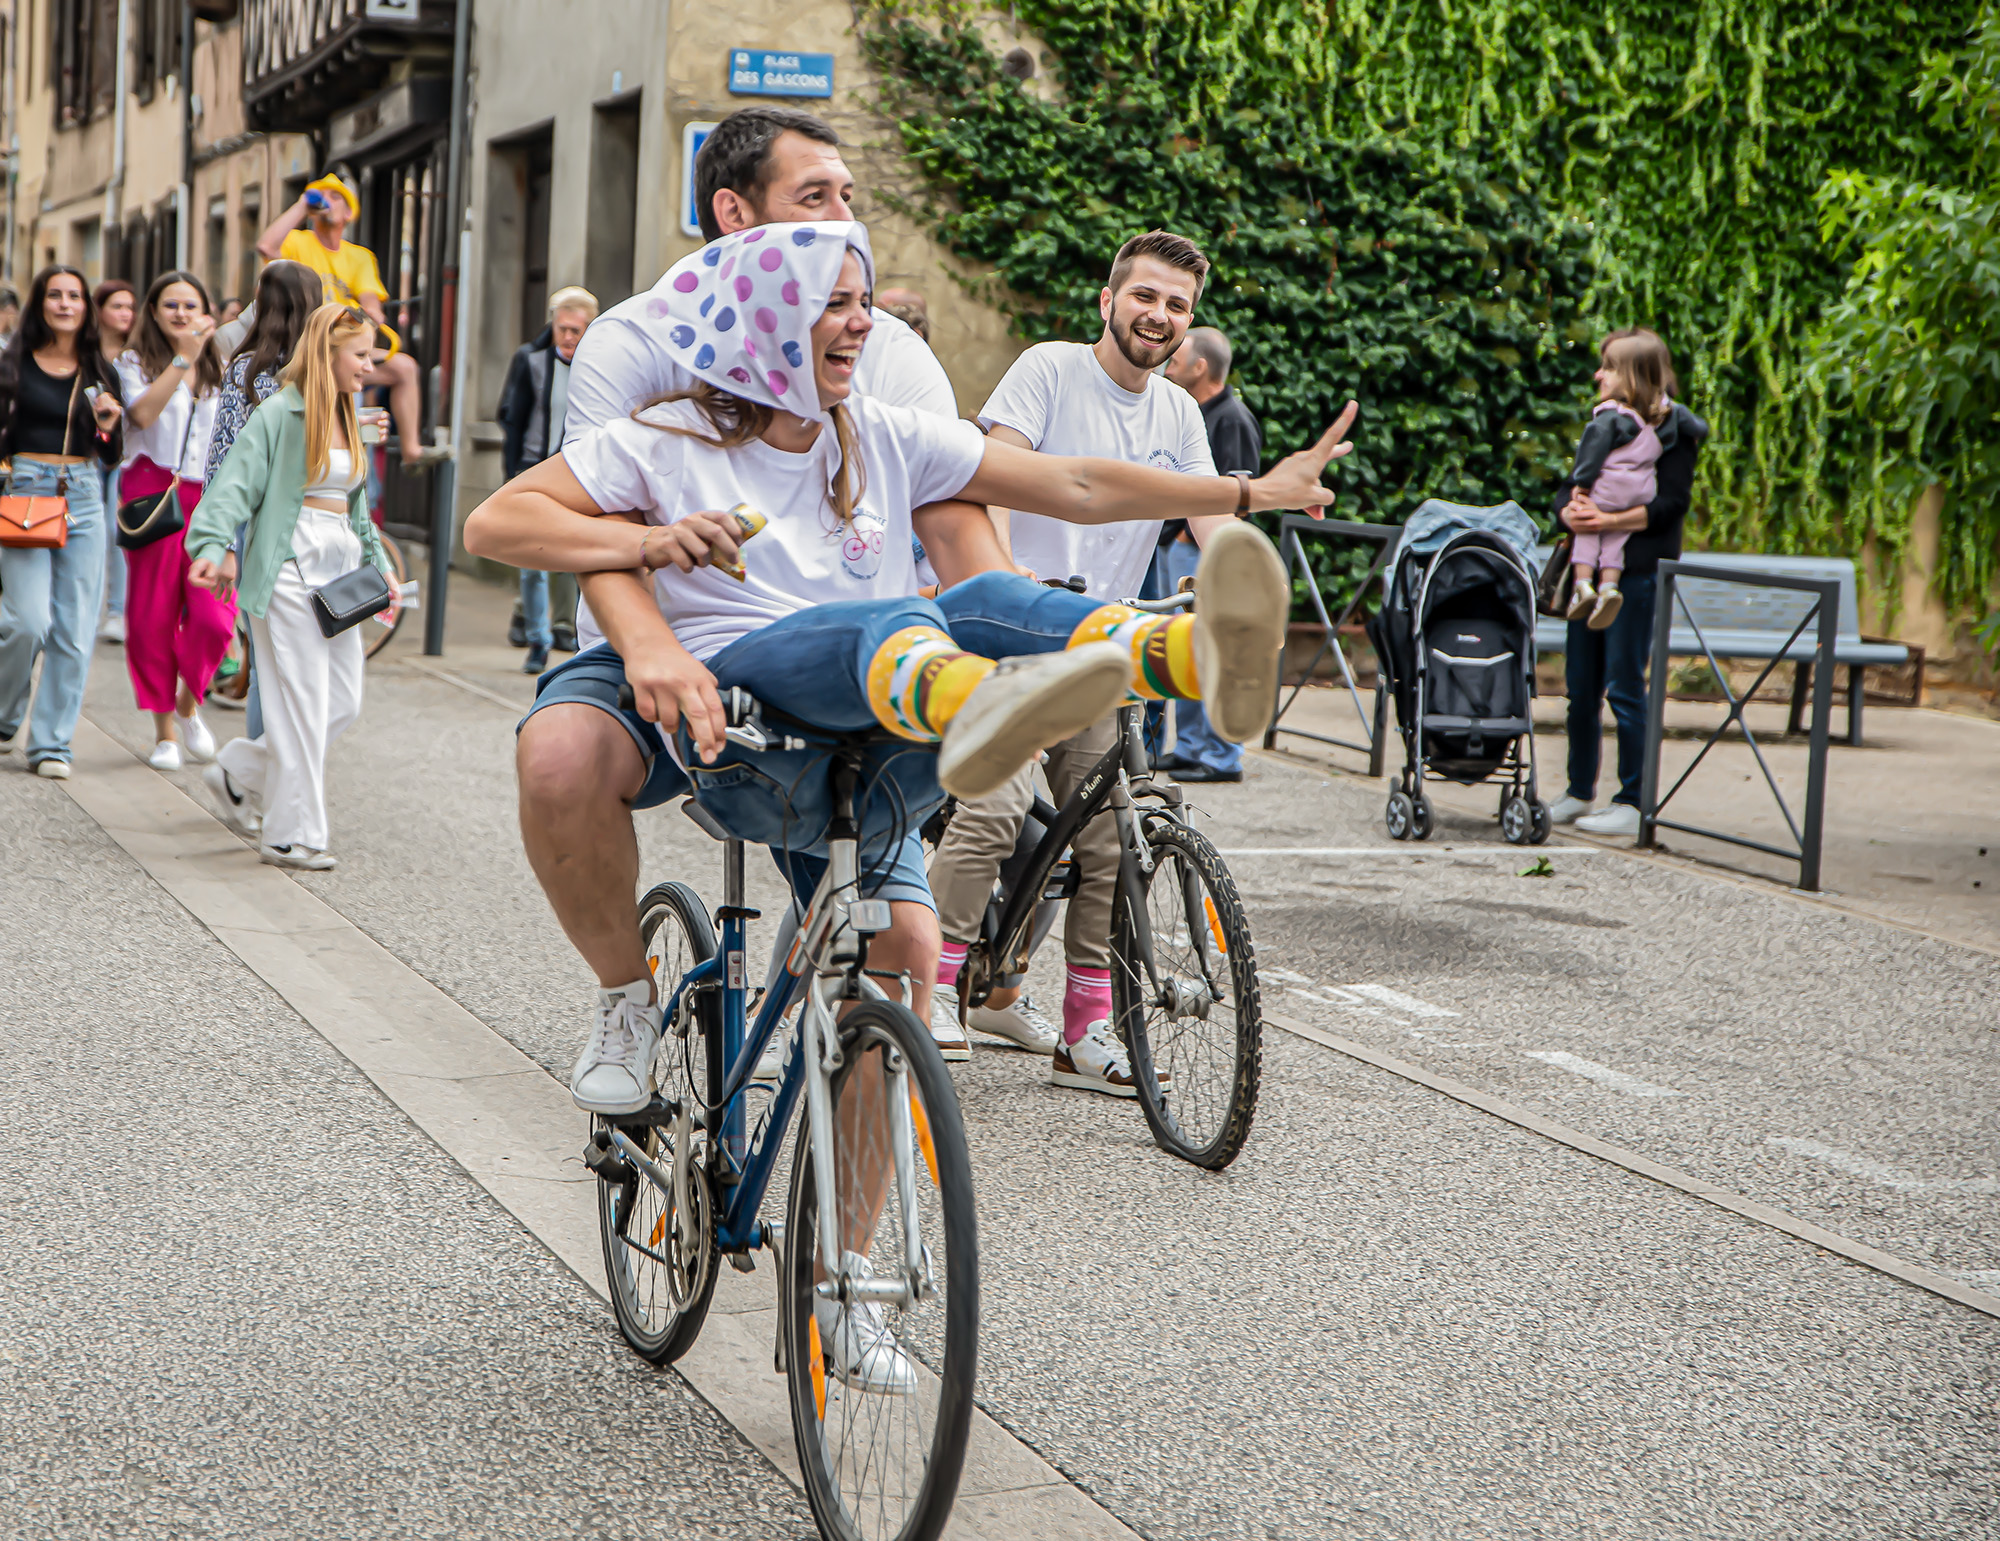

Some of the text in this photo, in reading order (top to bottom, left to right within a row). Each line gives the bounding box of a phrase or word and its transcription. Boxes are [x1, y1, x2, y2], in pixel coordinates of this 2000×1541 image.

[763, 54, 800, 68] PLACE
[734, 70, 828, 88] DES GASCONS
